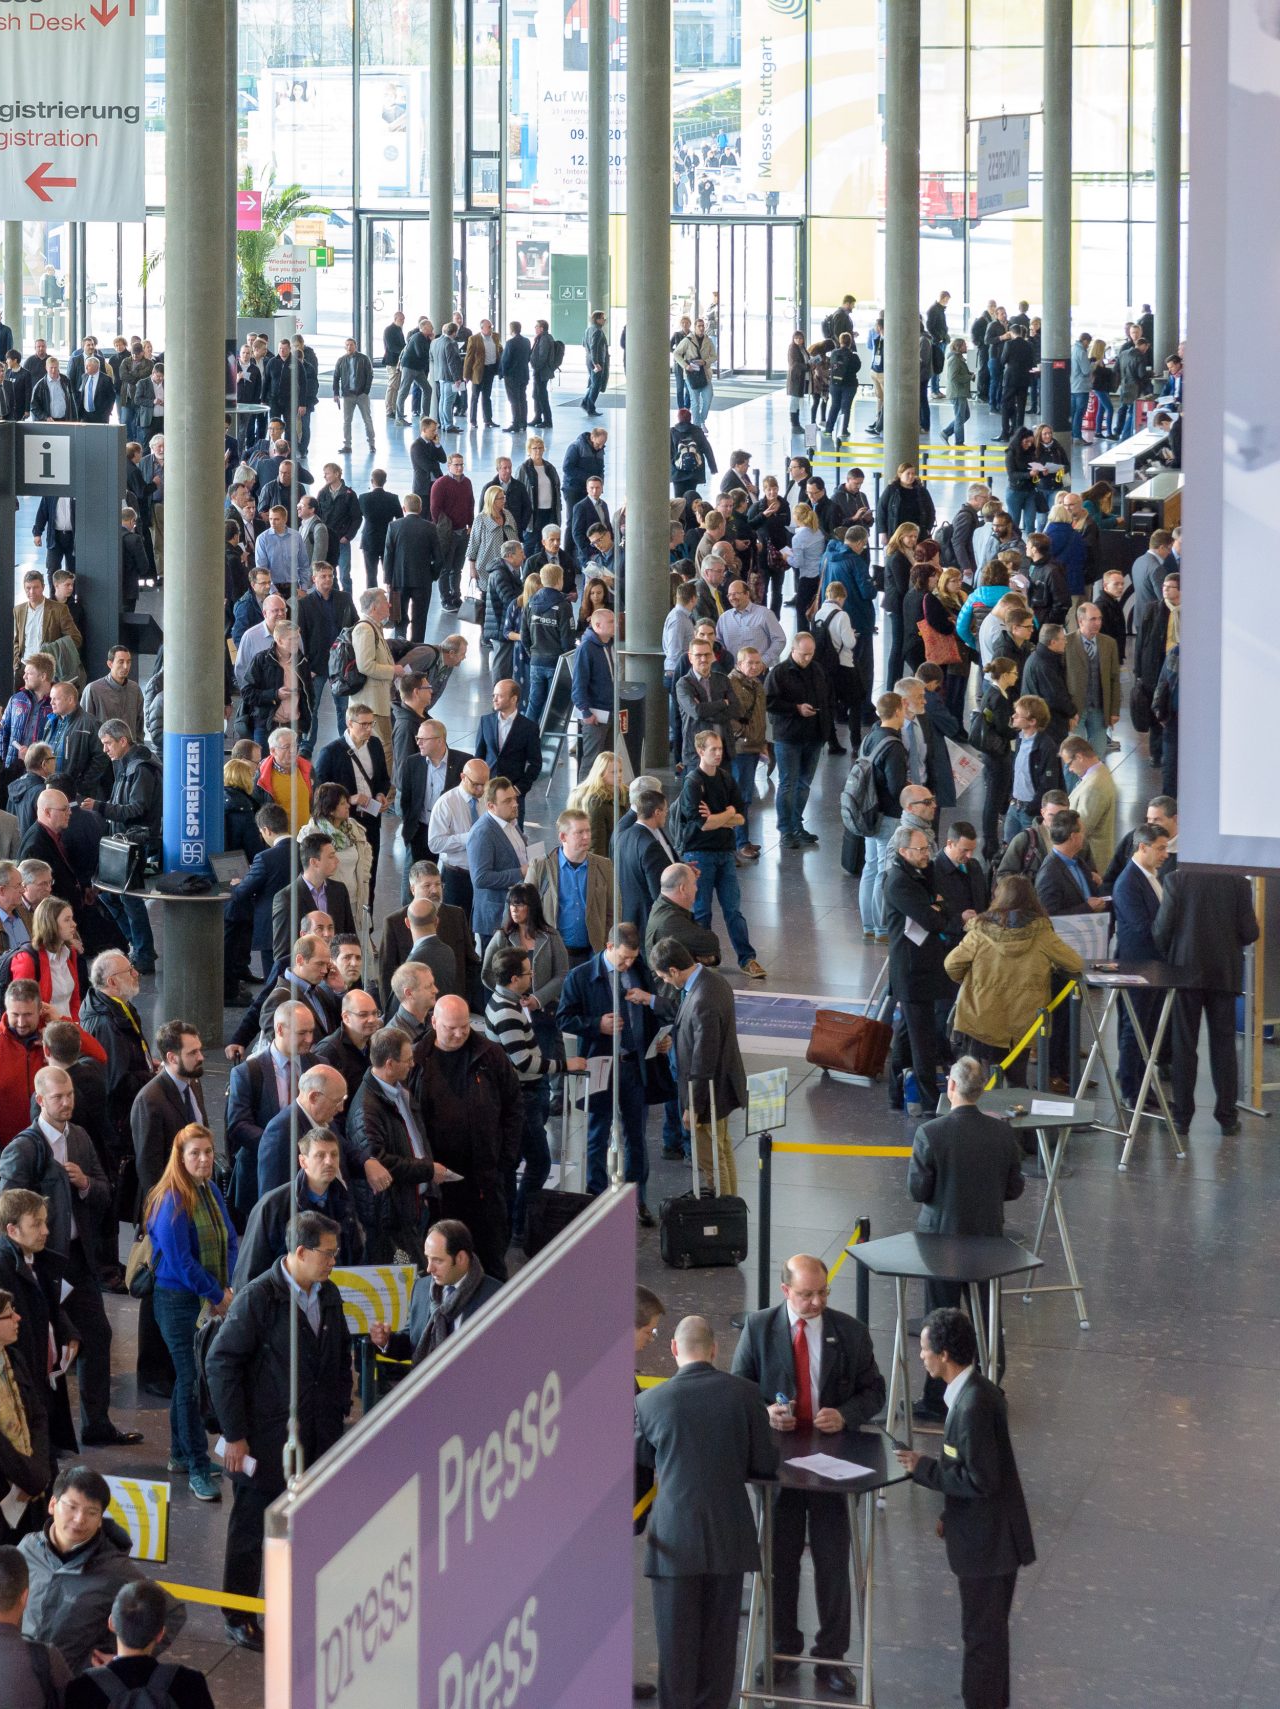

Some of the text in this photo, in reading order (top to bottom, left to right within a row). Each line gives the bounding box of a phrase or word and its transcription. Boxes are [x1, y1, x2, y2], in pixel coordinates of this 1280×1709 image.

[29, 12, 86, 31] Desk
[543, 90, 568, 103] Auf
[758, 35, 776, 178] Messe Stuttgart
[274, 275, 301, 283] Control
[186, 741, 200, 837] SPREITZER
[438, 1370, 561, 1574] Presse
[321, 1546, 413, 1709] press
